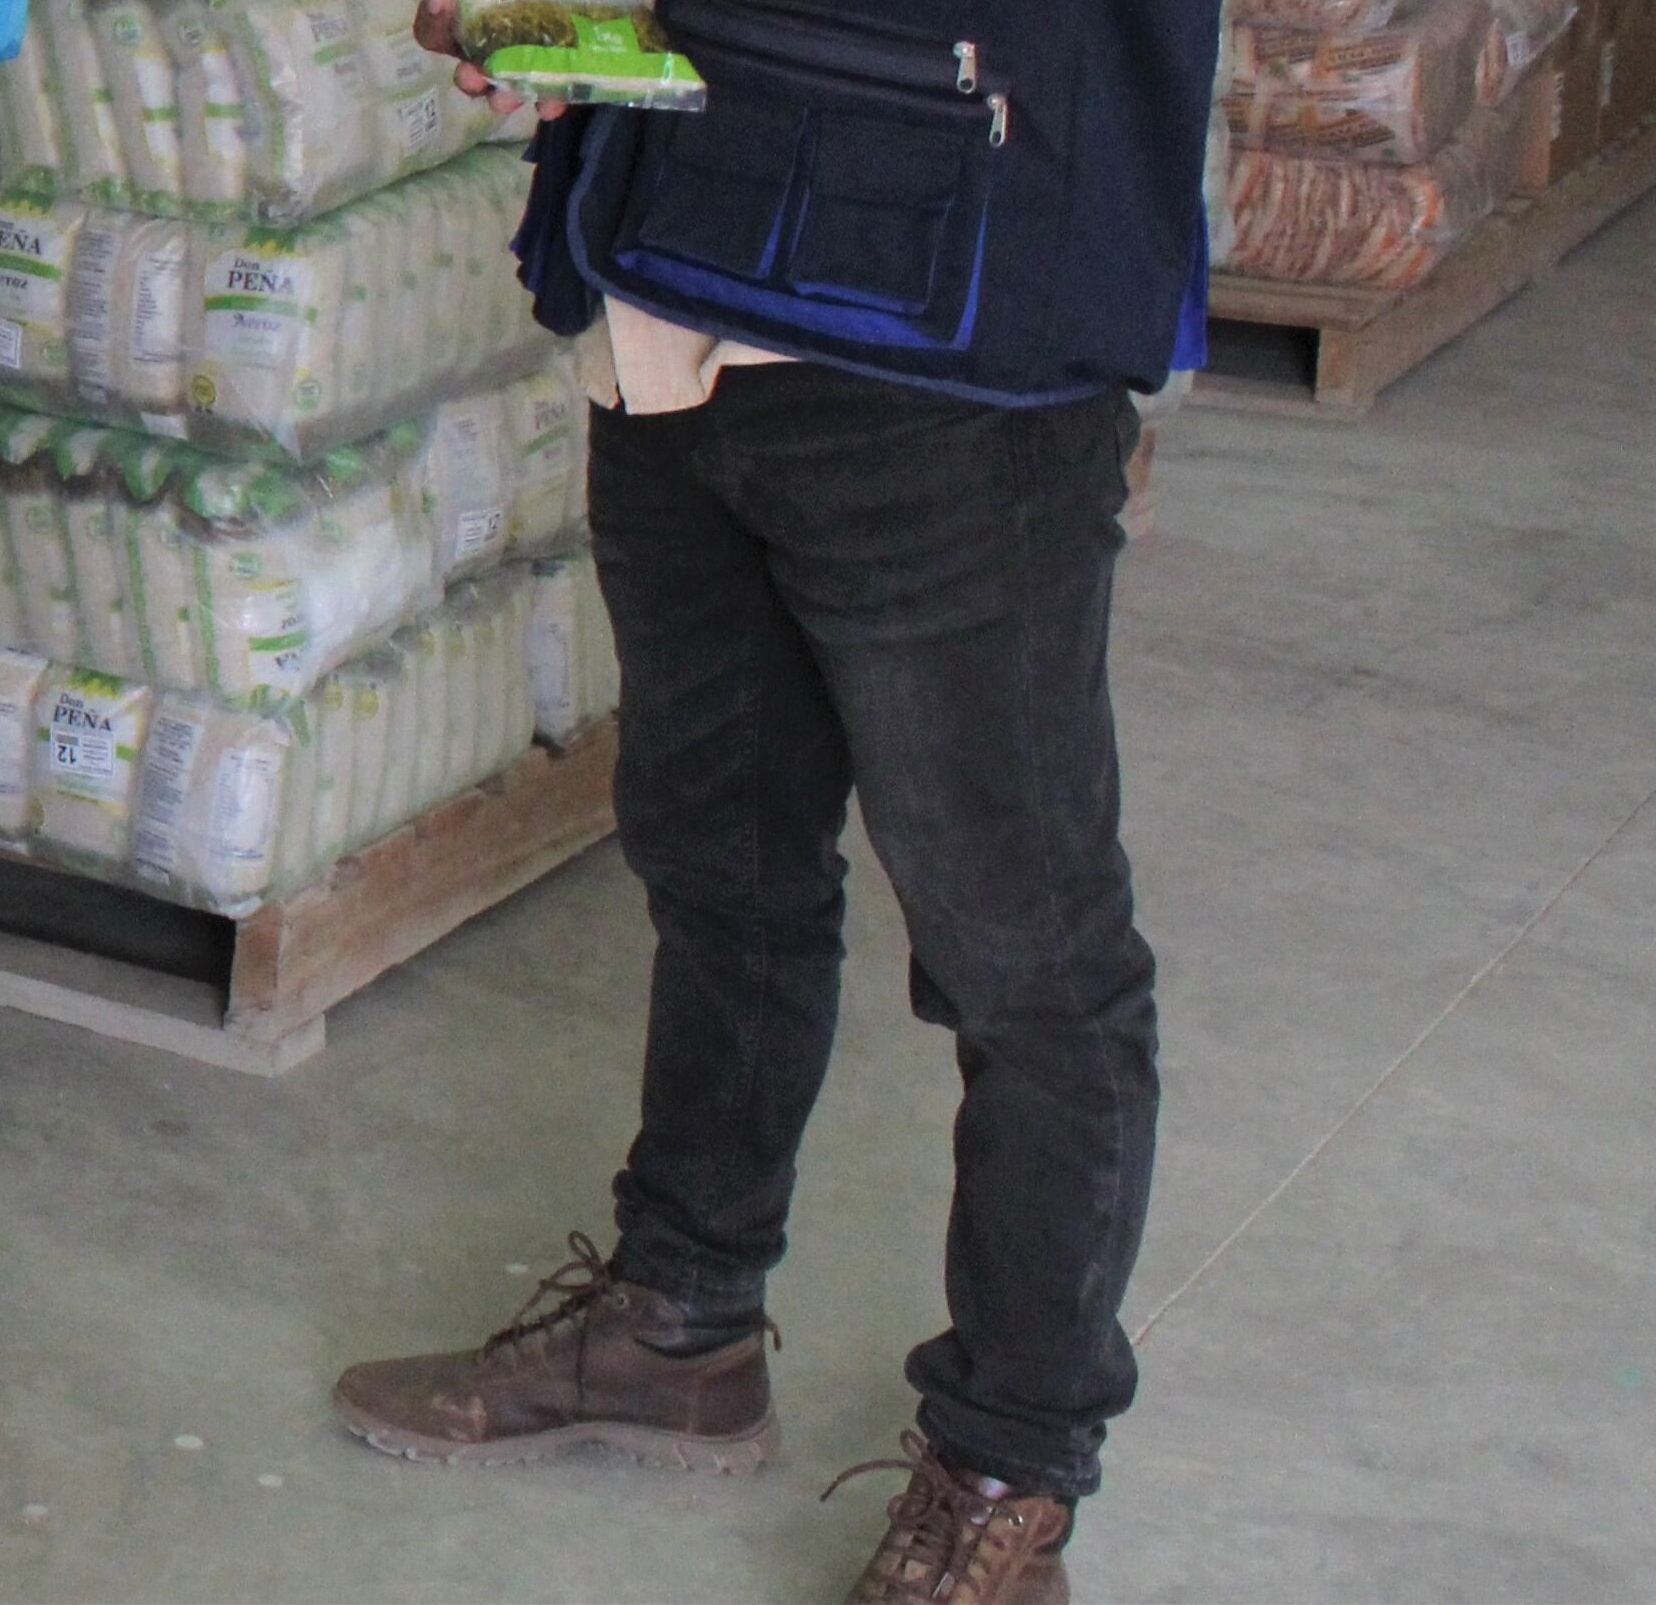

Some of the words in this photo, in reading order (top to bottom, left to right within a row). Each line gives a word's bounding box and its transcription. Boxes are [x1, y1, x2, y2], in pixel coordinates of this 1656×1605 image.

[234, 257, 261, 272] Don
[227, 268, 294, 294] PEÑA
[60, 693, 84, 710] Don
[53, 704, 114, 732] PEÑA
[57, 745, 77, 765] 12
